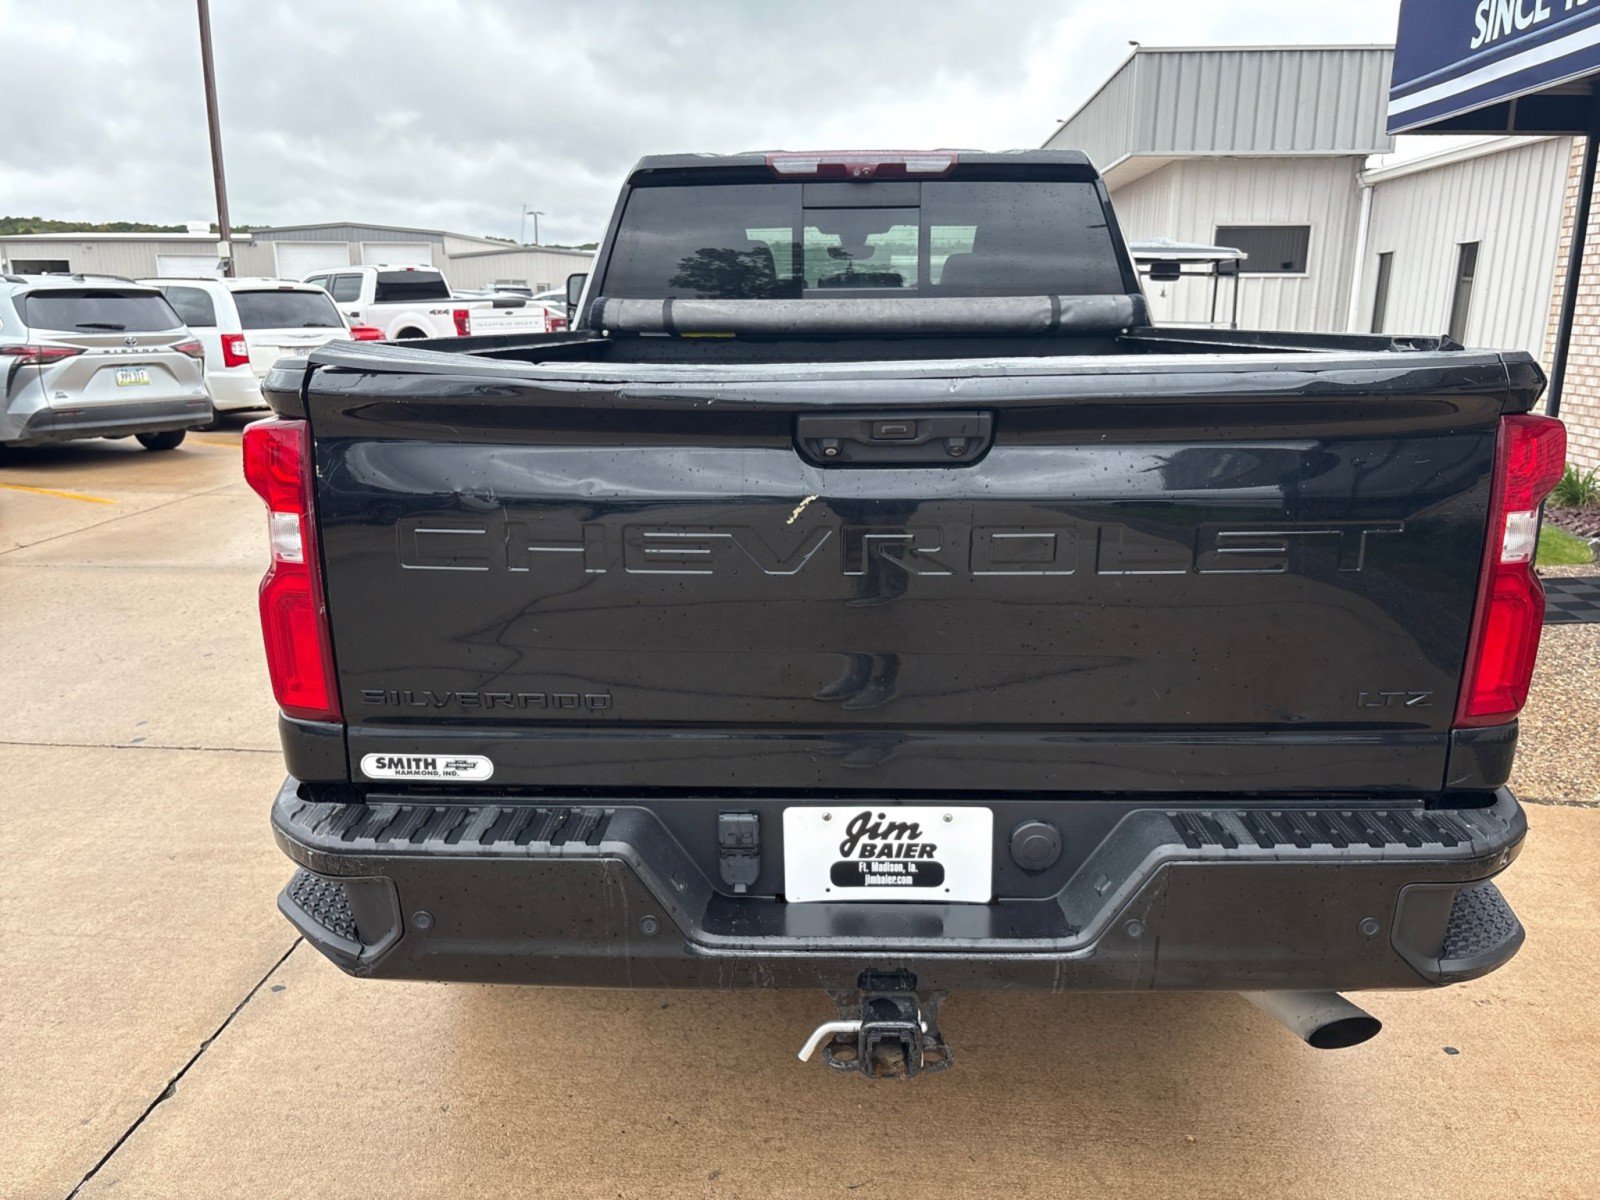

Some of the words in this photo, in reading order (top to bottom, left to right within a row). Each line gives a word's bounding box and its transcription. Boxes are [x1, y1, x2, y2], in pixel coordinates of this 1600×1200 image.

[397, 518, 1405, 577] CHEVROLET
[360, 689, 614, 711] SILVERADO
[1357, 690, 1434, 708] LTZ
[375, 757, 437, 770] SMITH
[395, 769, 441, 777] HAMMOND,
[839, 810, 923, 858] Jim
[858, 843, 938, 859] BAIER
[858, 861, 869, 873] Ft.
[871, 861, 906, 874] Madison,
[864, 874, 913, 886] jimbaier.com
